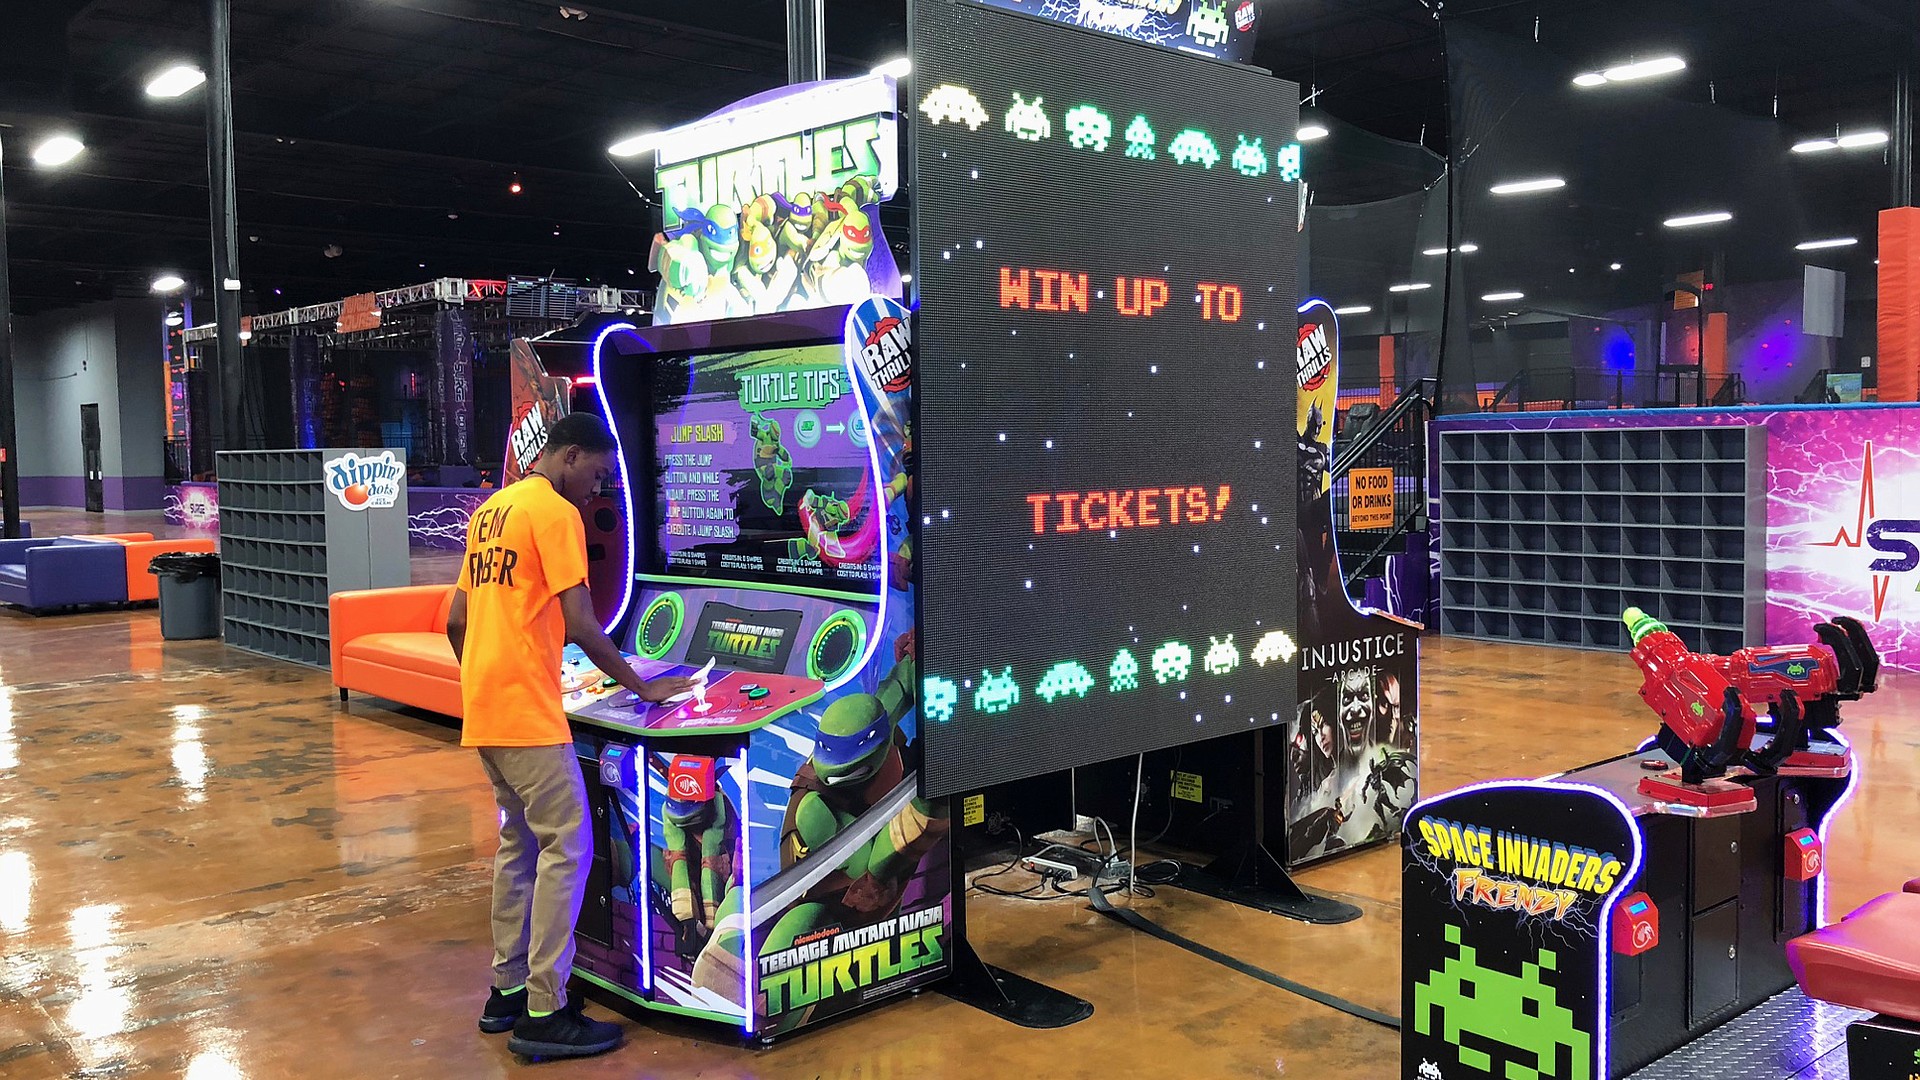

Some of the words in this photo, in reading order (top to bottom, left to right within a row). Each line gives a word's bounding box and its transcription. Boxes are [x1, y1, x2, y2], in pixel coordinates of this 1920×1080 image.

[657, 117, 884, 231] TURTLES
[999, 267, 1088, 312] WIN
[1115, 275, 1168, 316] UP
[1197, 282, 1242, 321] TO
[741, 372, 799, 403] TURTLE
[803, 369, 841, 401] TIPS
[511, 401, 543, 460] RAW
[671, 425, 693, 443] JUMP
[695, 423, 724, 442] SLASH
[517, 427, 549, 474] THRILLS
[665, 454, 684, 466] PRESS
[684, 454, 696, 466] THE
[697, 454, 713, 466] JUMP
[330, 456, 400, 490] dippin'
[367, 483, 394, 496] dots
[665, 472, 688, 484] BUTTON
[688, 472, 701, 484] AND
[702, 472, 720, 484] WHILE
[1355, 476, 1367, 490] NO
[1368, 475, 1388, 489] FOOD
[666, 506, 681, 518] JUMP
[681, 507, 705, 519] BUTTON
[706, 508, 724, 520] AGAIN
[725, 508, 734, 520] TO
[687, 490, 706, 502] PRESS
[707, 490, 720, 502] THE
[1026, 484, 1231, 534] TICKETS!
[1352, 496, 1363, 509] OR
[1364, 494, 1392, 509] DRINKS
[666, 523, 691, 535] EXECUTE
[698, 524, 713, 537] JUMP
[1352, 514, 1369, 523] BEYOND
[1370, 513, 1379, 521] THIS
[706, 630, 780, 660] TURTLES
[1301, 632, 1404, 671] INJUSTICE
[1418, 815, 1494, 870] SPACE
[1496, 830, 1622, 894] INVADERS
[1453, 867, 1578, 920] FRENZY
[760, 940, 828, 975] TEENAGE
[832, 918, 897, 954] MUTANT
[899, 905, 943, 933] NINJA
[760, 923, 943, 1017] TURTLES
